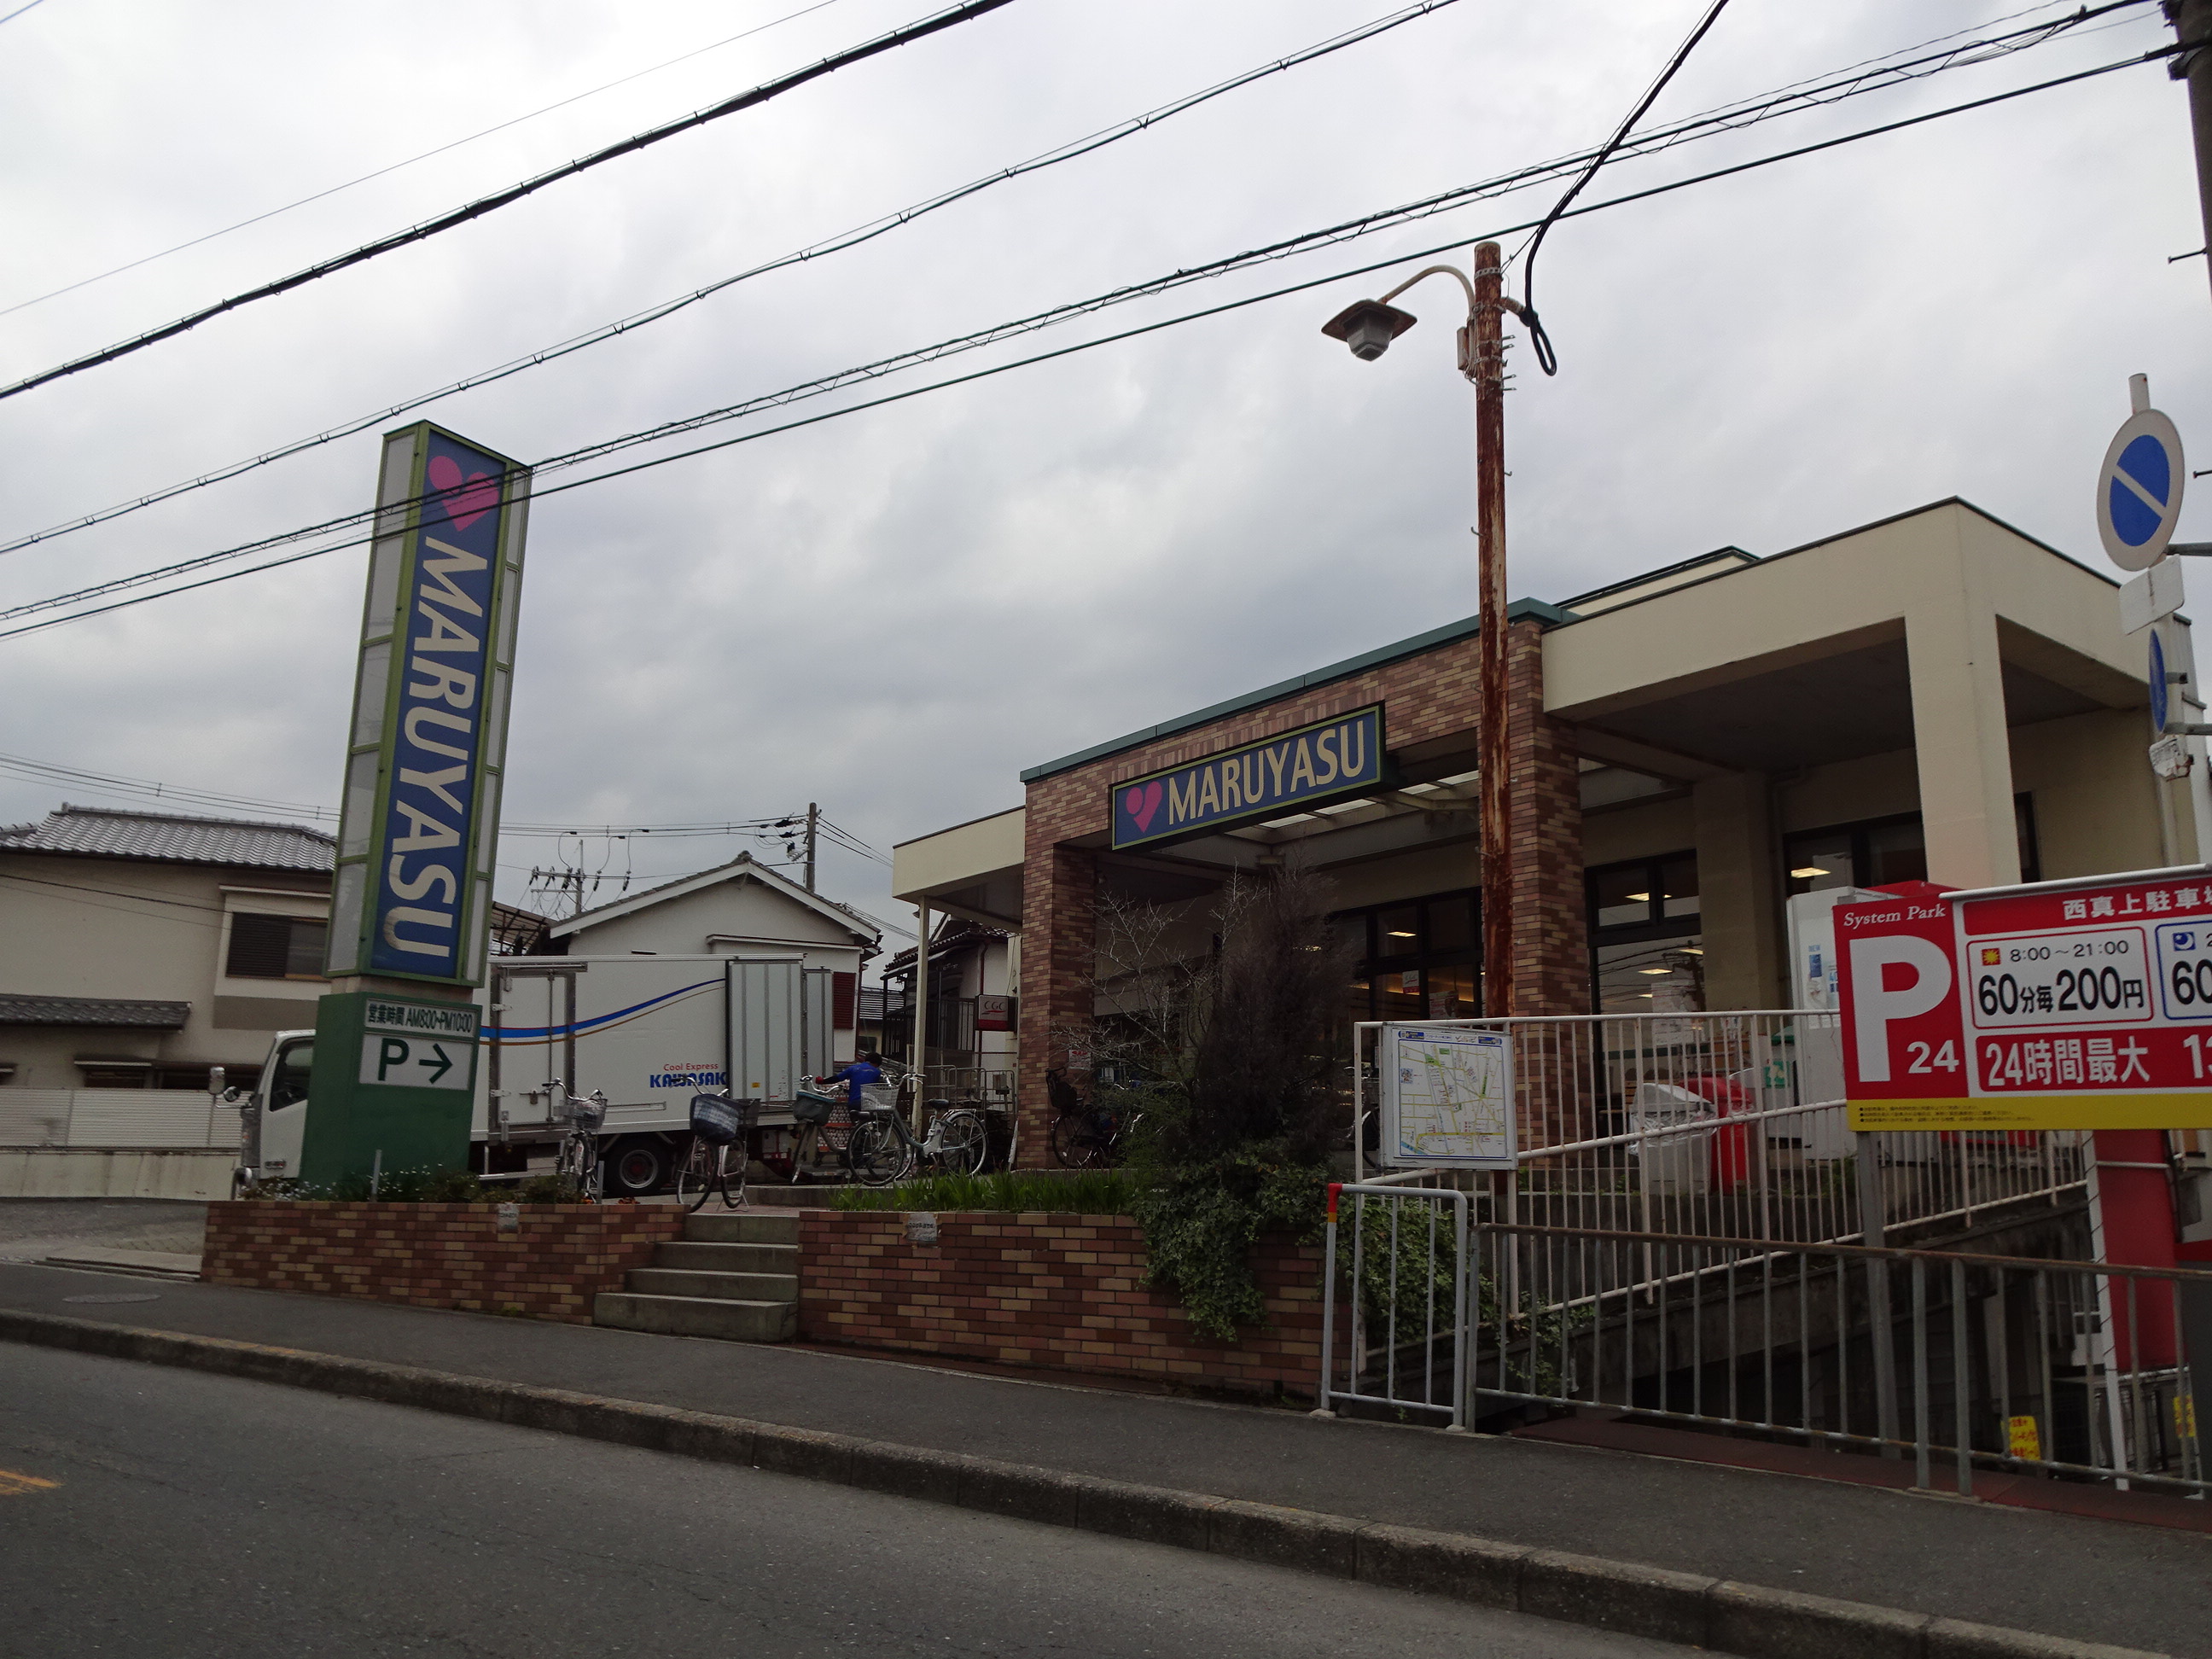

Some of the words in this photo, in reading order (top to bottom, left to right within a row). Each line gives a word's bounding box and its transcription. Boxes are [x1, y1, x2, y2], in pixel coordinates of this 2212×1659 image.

[382, 536, 489, 958] MARUYASU
[1168, 720, 1365, 825] MARUYASU
[1843, 911, 1901, 929] System
[1906, 903, 1947, 920] Park
[2062, 885, 2212, 921] 西真上駐車
[1848, 934, 1953, 1082] P
[1978, 965, 2145, 1016] 60分毎200円
[378, 1038, 410, 1081] P
[663, 1063, 683, 1072] Cool
[685, 1062, 719, 1072] Express
[1906, 1039, 1960, 1074] 24
[1985, 1035, 2151, 1087] 24時間最大
[649, 1072, 728, 1088] KAWASAK
